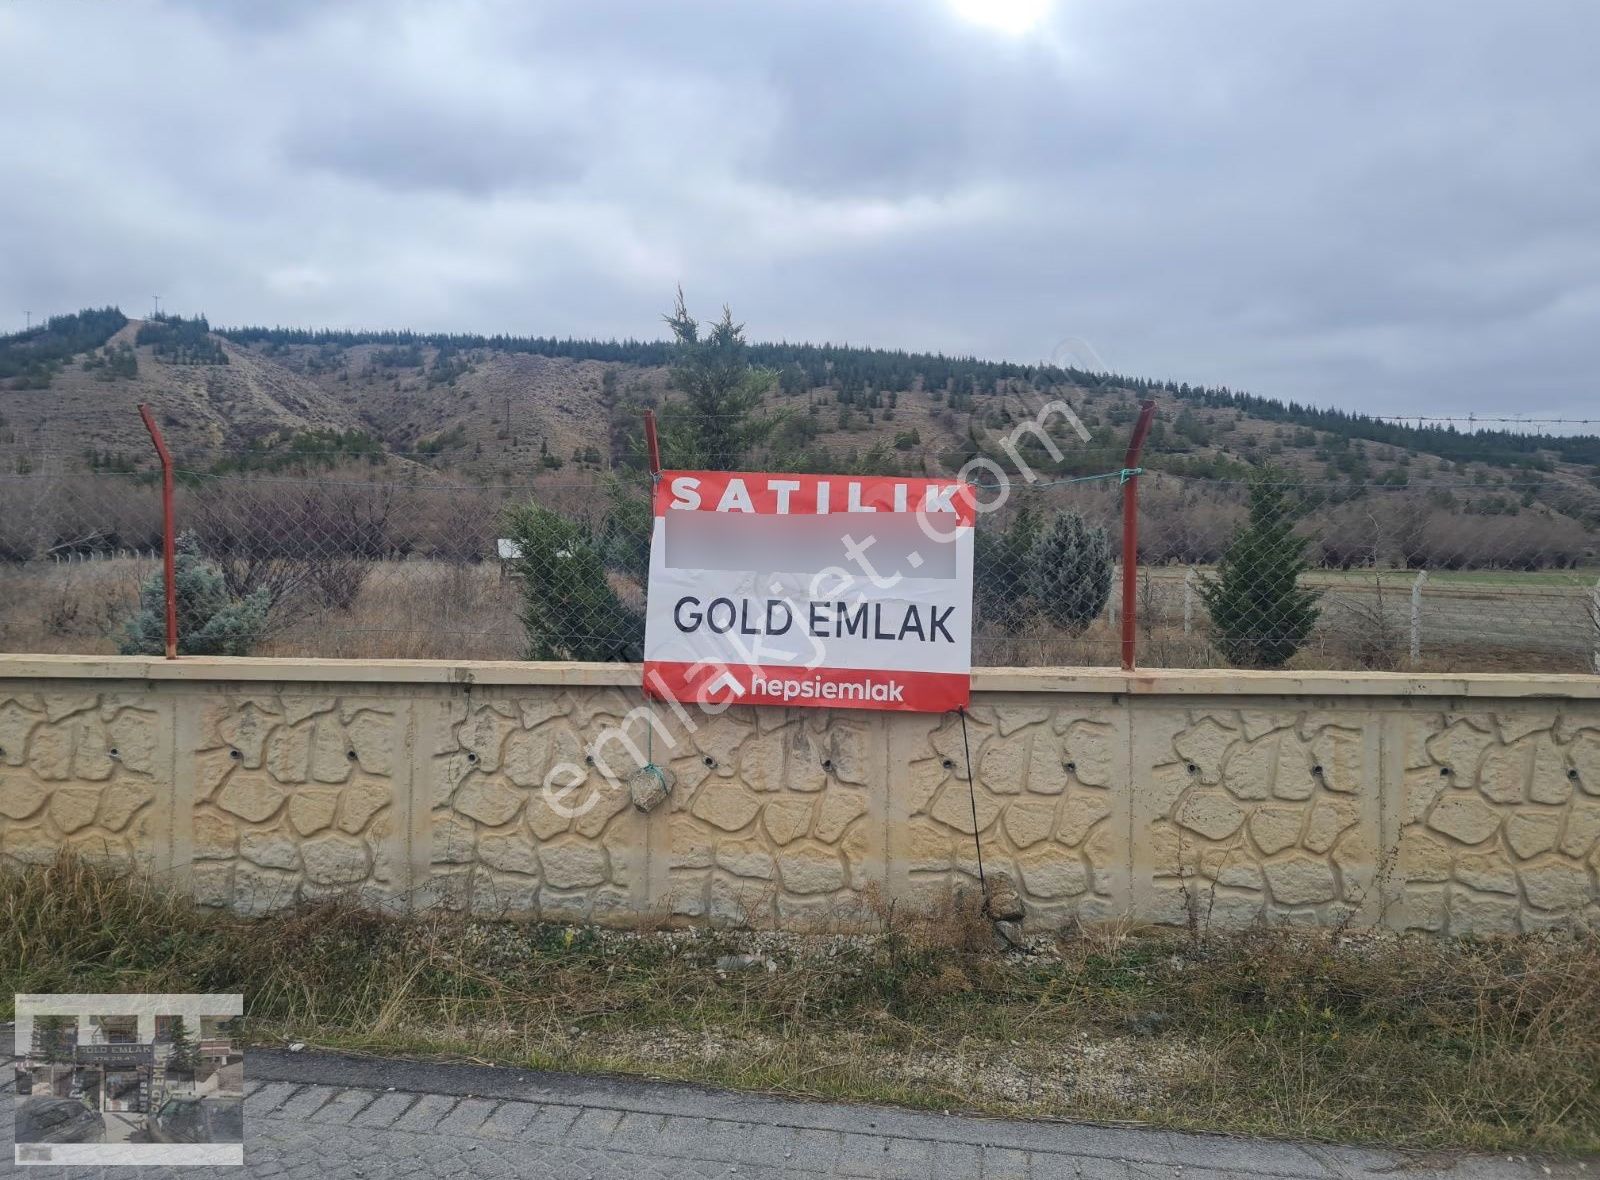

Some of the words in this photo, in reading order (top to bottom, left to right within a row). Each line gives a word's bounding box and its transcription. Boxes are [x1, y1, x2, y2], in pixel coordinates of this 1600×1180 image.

[670, 477, 960, 520] SATILIK
[673, 596, 793, 637] GOLD
[809, 600, 956, 643] EMLAK
[751, 675, 905, 702] hepsiemlak
